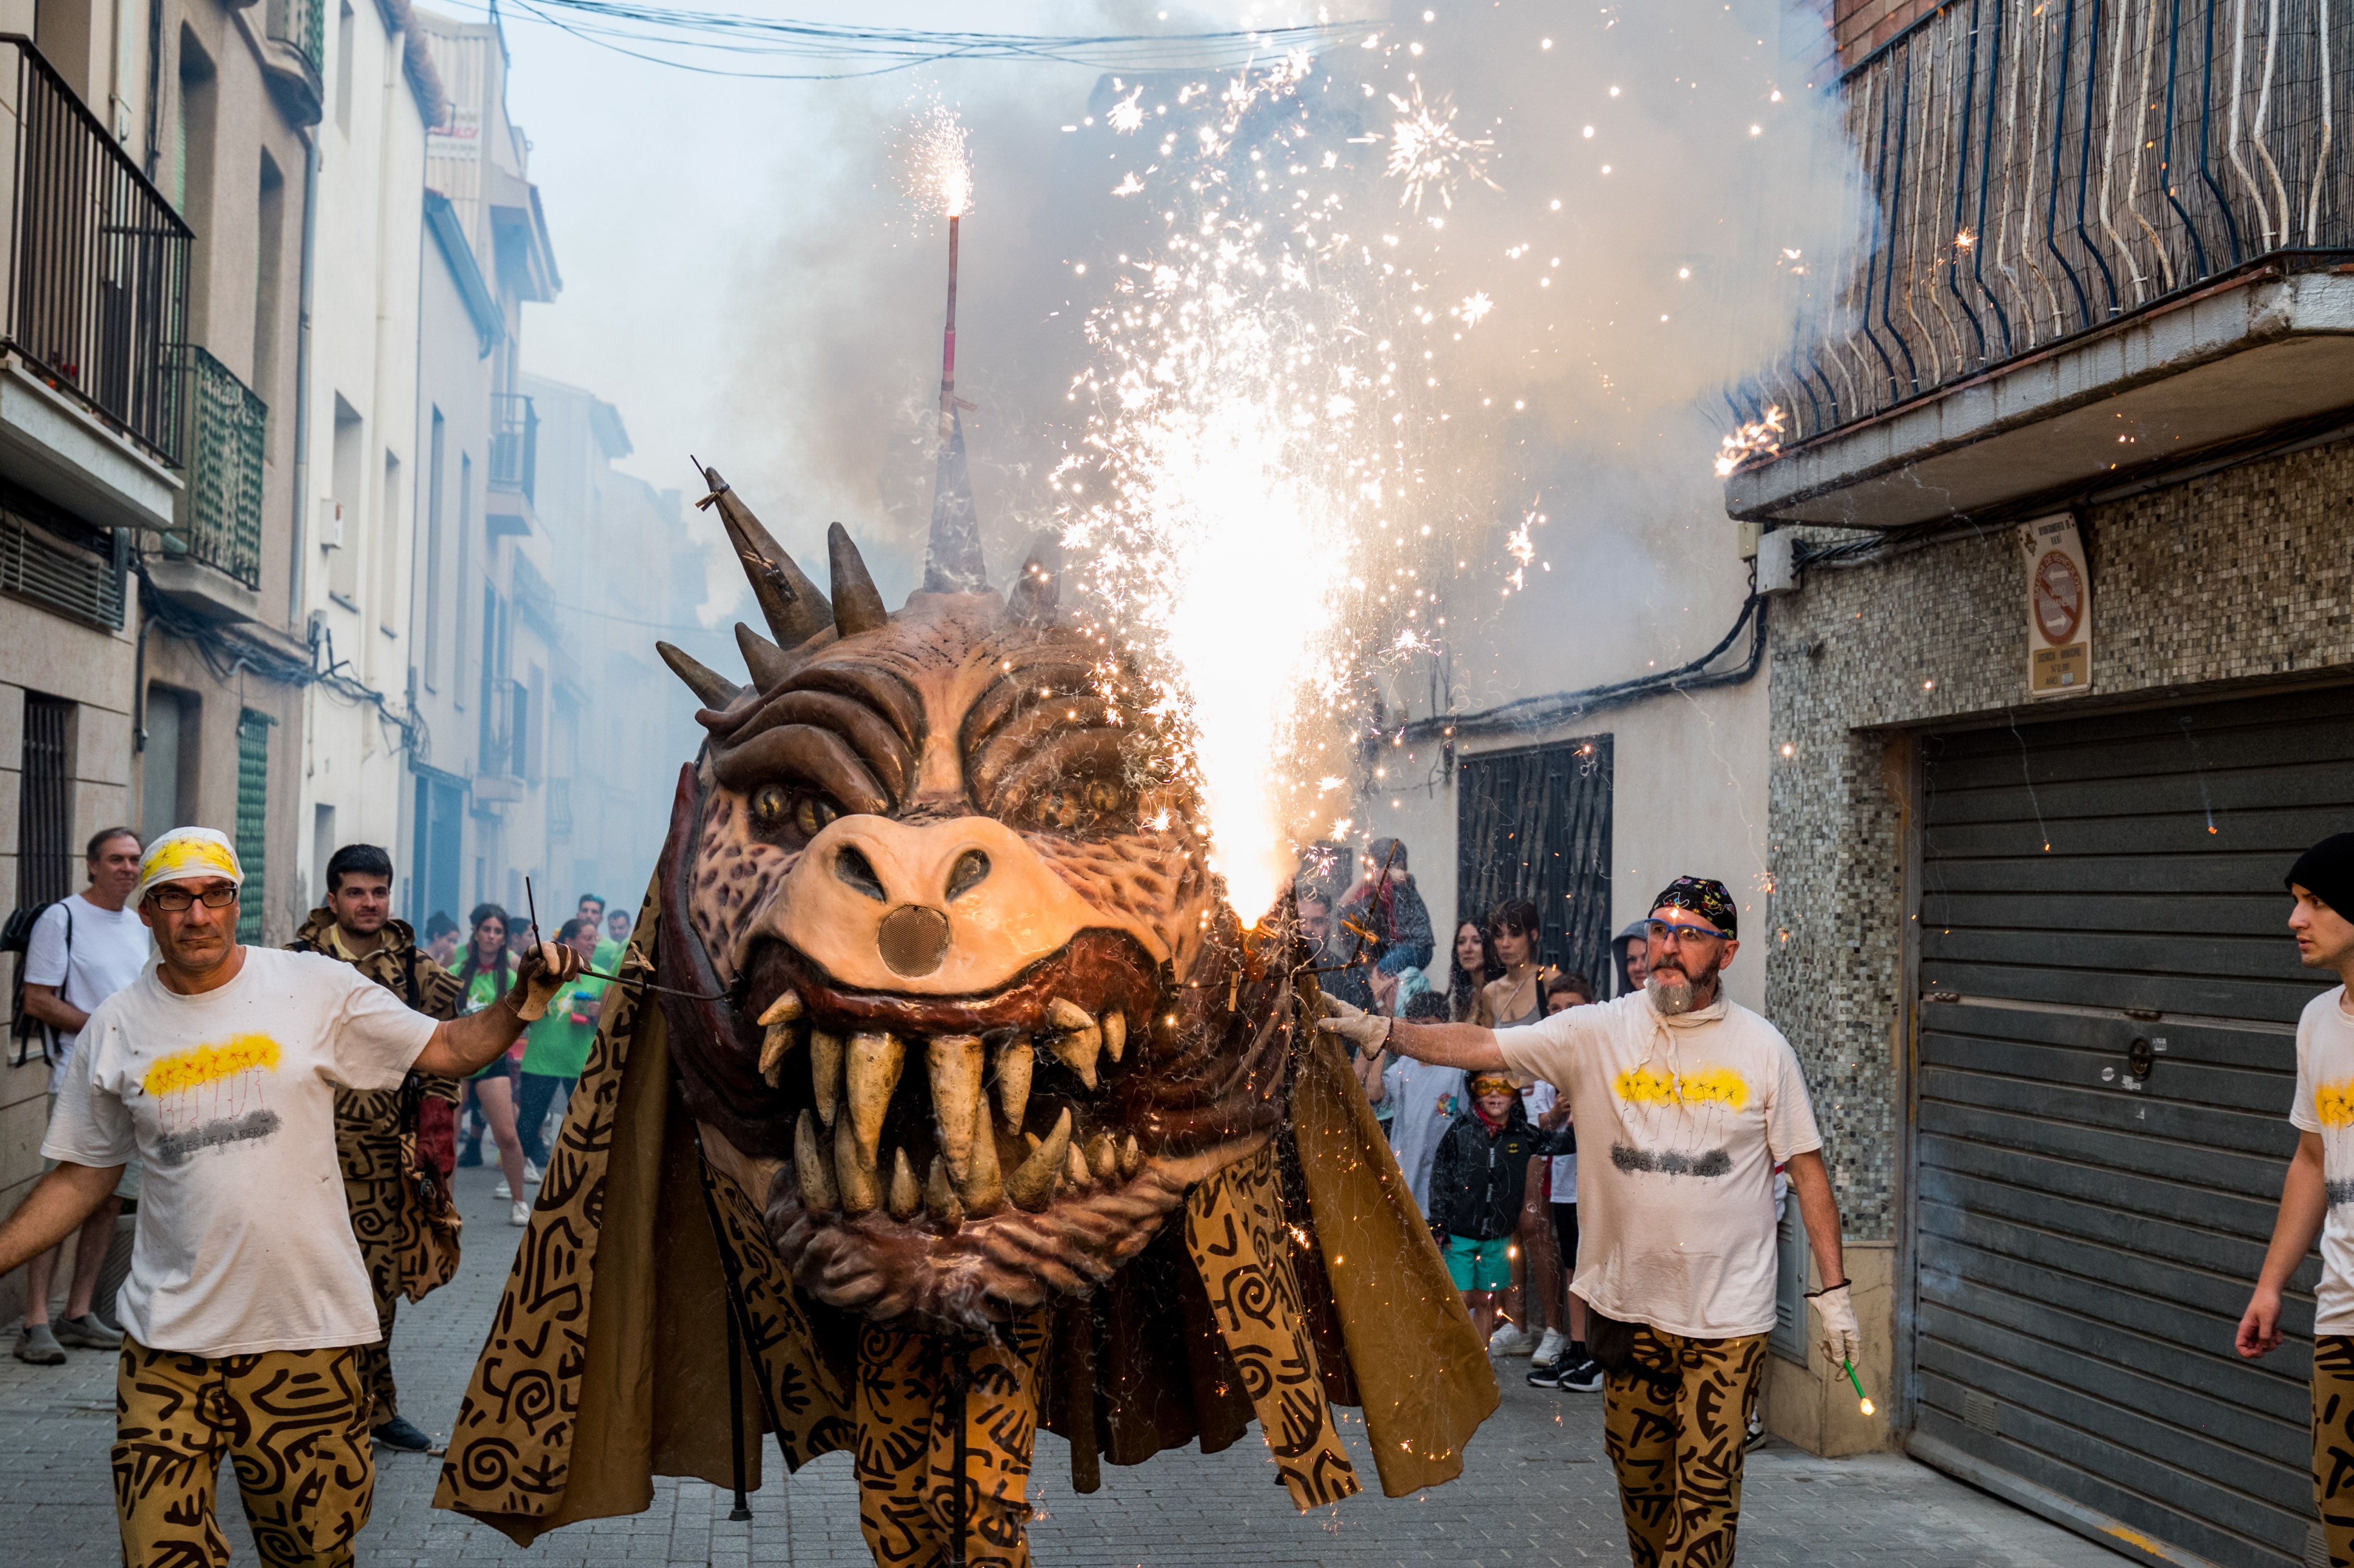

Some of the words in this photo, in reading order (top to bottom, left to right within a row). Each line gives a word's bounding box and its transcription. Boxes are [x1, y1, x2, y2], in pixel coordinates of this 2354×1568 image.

[203, 1135, 217, 1147] DE
[220, 1133, 235, 1144] LA
[239, 1127, 269, 1140] RIERA
[1615, 1154, 1651, 1171] DIABLES
[1655, 1164, 1670, 1173] DE
[1673, 1165, 1688, 1175] LA
[1693, 1166, 1721, 1177] RIERA
